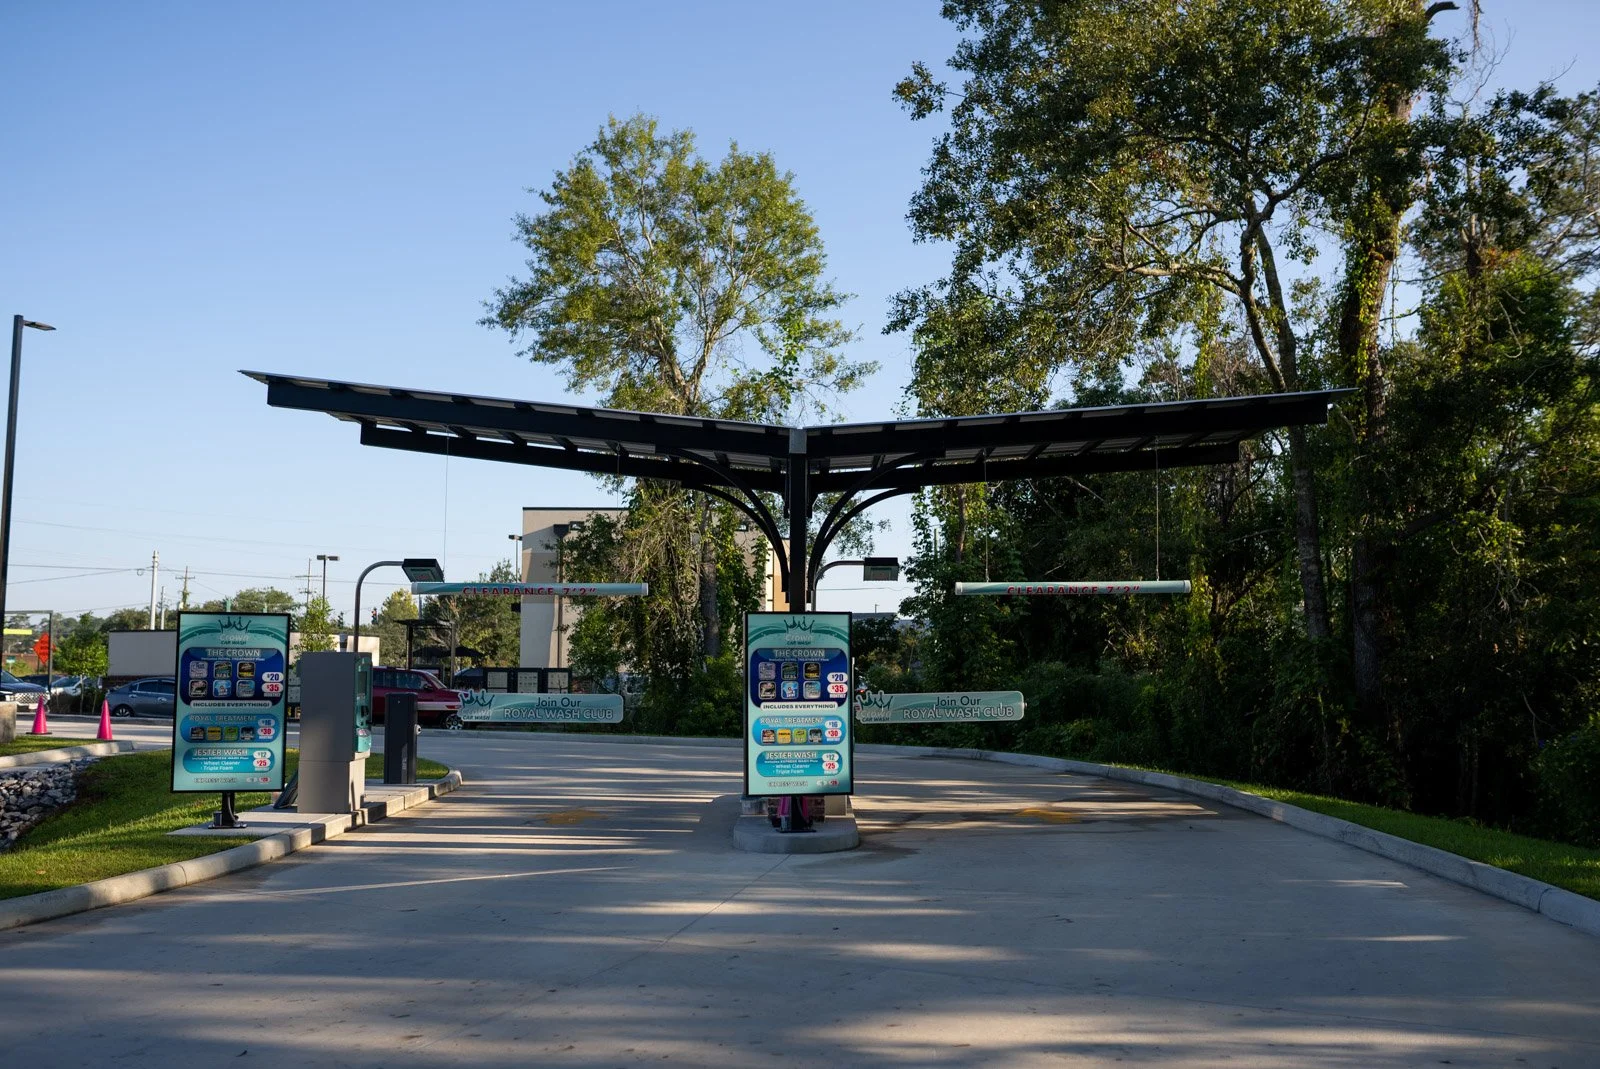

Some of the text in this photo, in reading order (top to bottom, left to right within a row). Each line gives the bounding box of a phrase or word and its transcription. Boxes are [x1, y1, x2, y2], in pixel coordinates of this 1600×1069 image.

[463, 587, 554, 595] CLEARANCE
[1007, 586, 1098, 594] CLEARANCE
[226, 649, 260, 657] CROWN
[266, 673, 280, 681] $20
[266, 684, 279, 692] $35
[536, 697, 582, 707] Join Our
[935, 696, 982, 707] Join Our
[504, 709, 613, 720] ROYAL WASH CLUB
[904, 707, 1014, 718] ROYAL WASH CLUB
